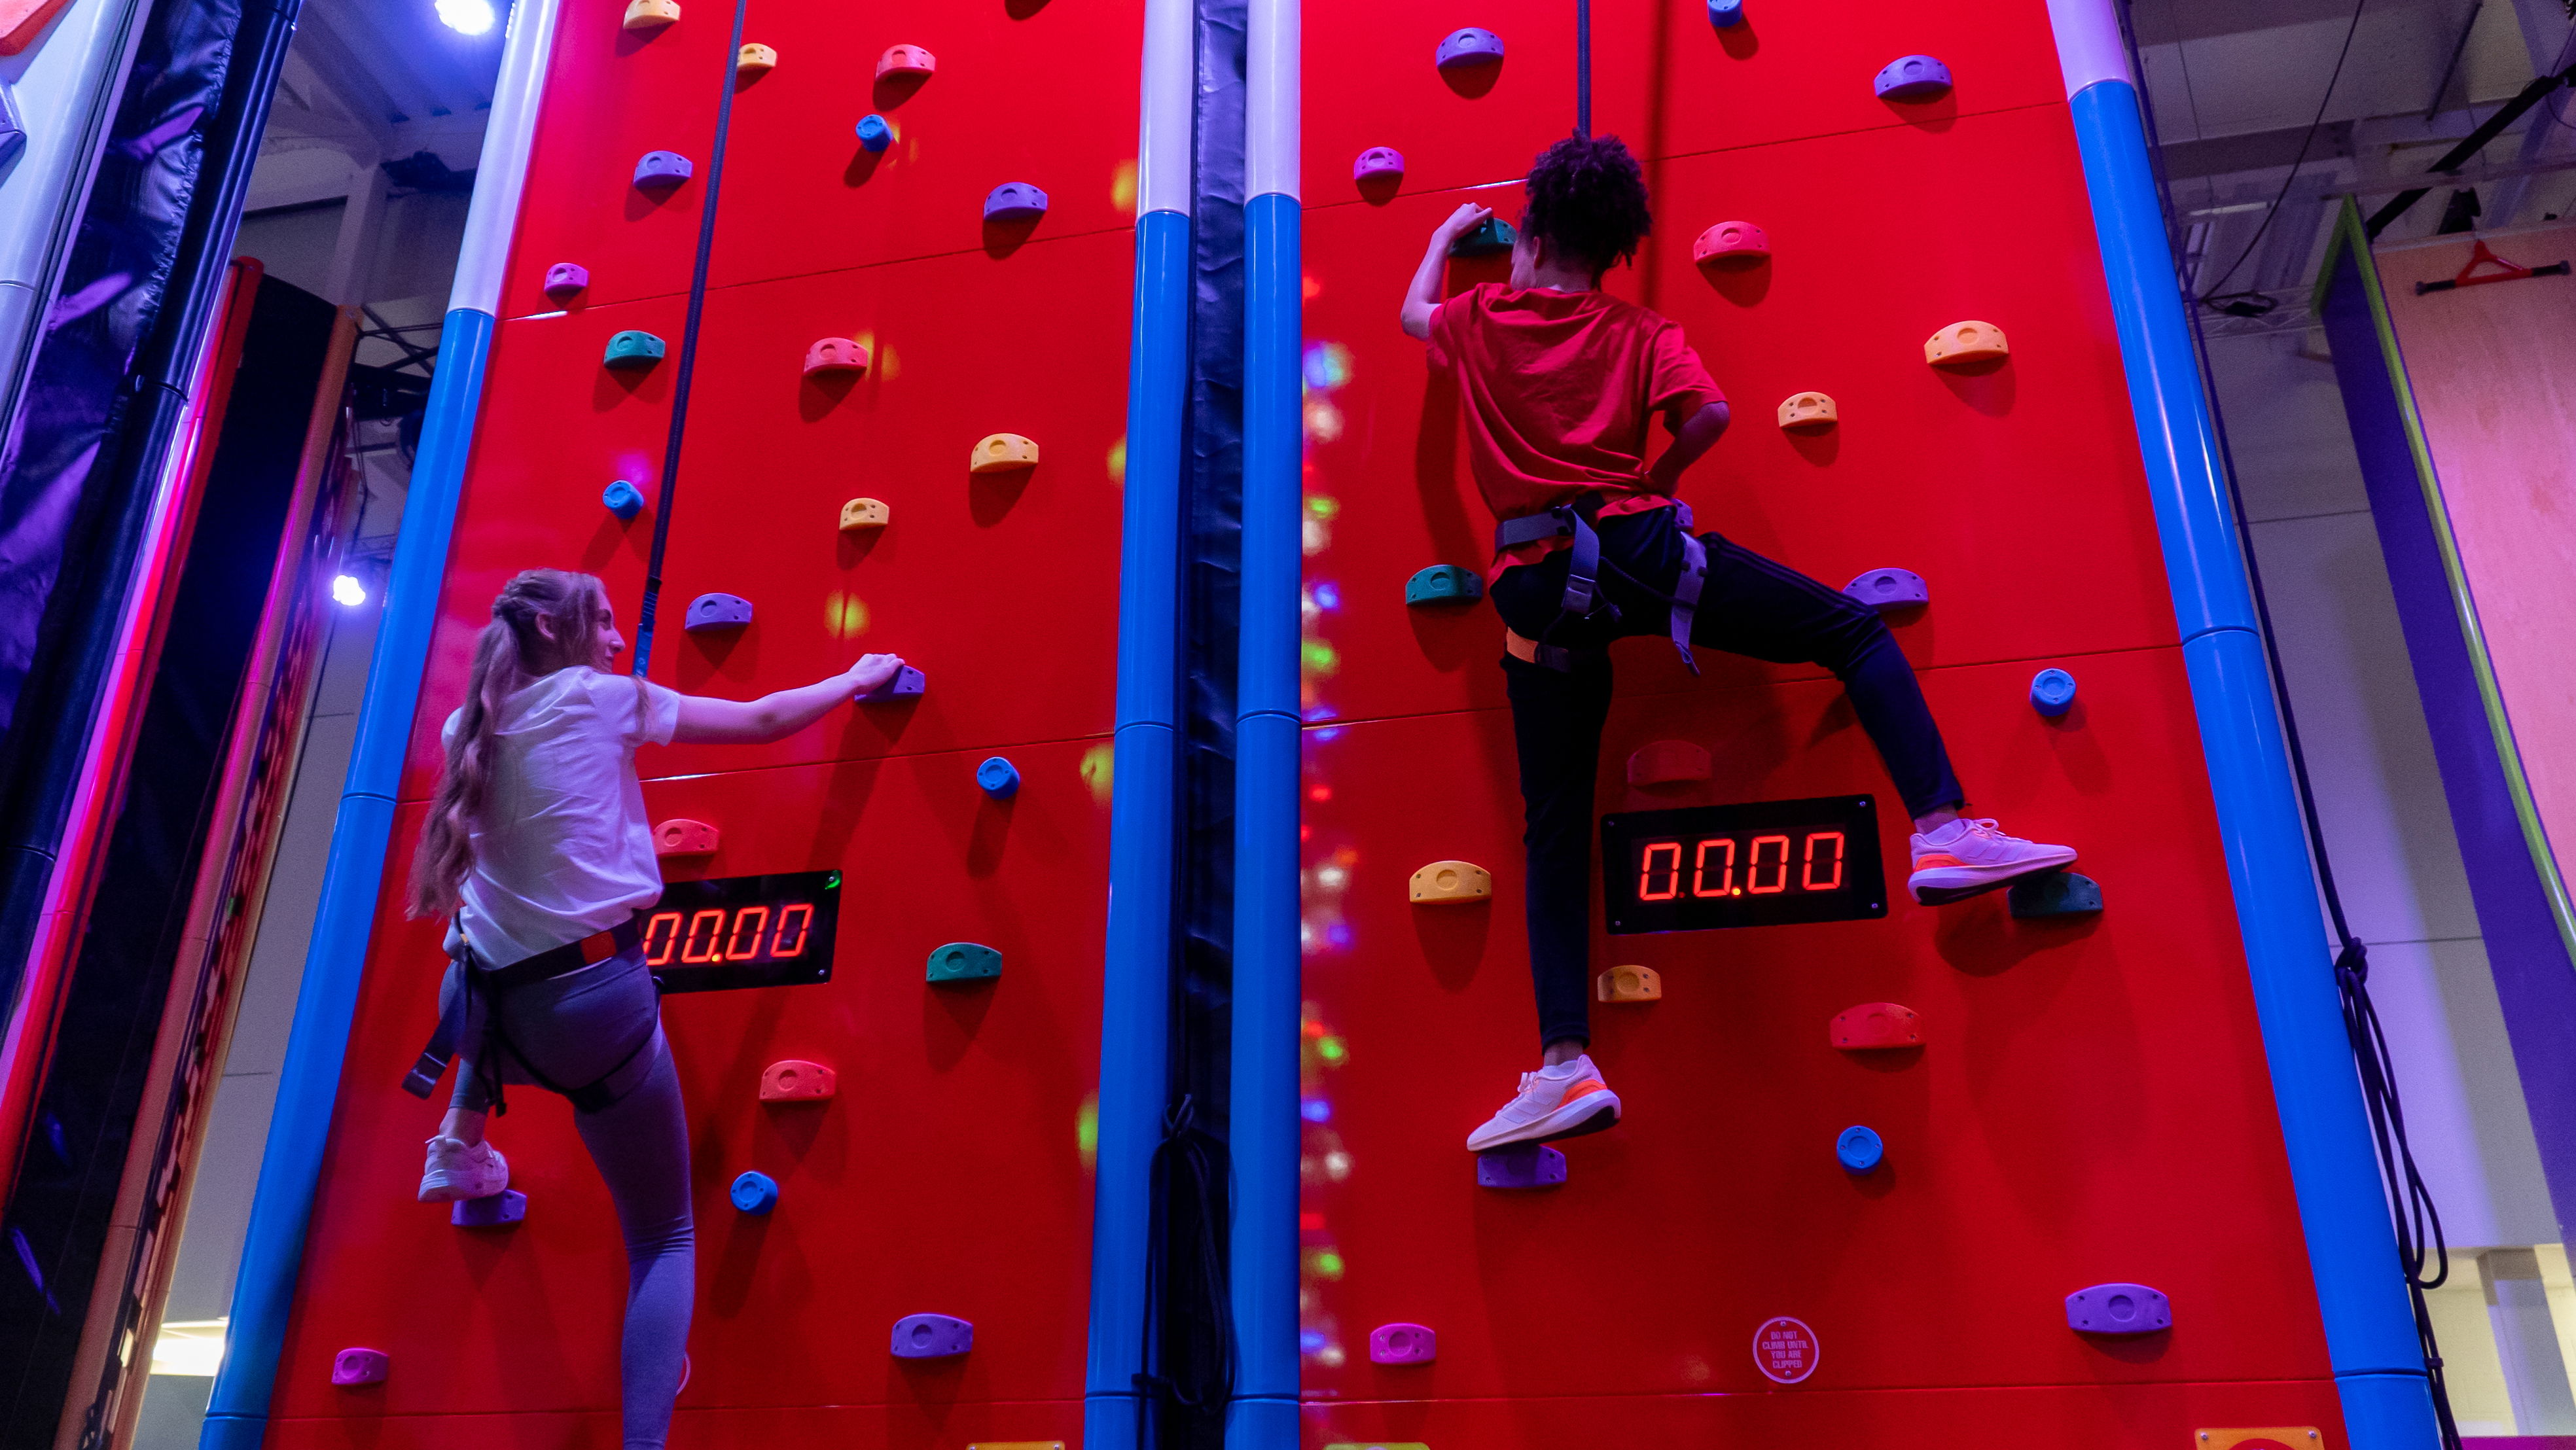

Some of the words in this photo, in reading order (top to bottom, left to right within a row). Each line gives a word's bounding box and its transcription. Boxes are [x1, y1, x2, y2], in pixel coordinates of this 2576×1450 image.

[1639, 832, 1844, 900] 00.00
[1783, 1331, 1797, 1339] NOT
[1787, 1340, 1809, 1349] UNTIL
[1770, 1351, 1785, 1359] YOU
[1788, 1350, 1802, 1358] ARE
[1772, 1360, 1802, 1369] CLIPPED
